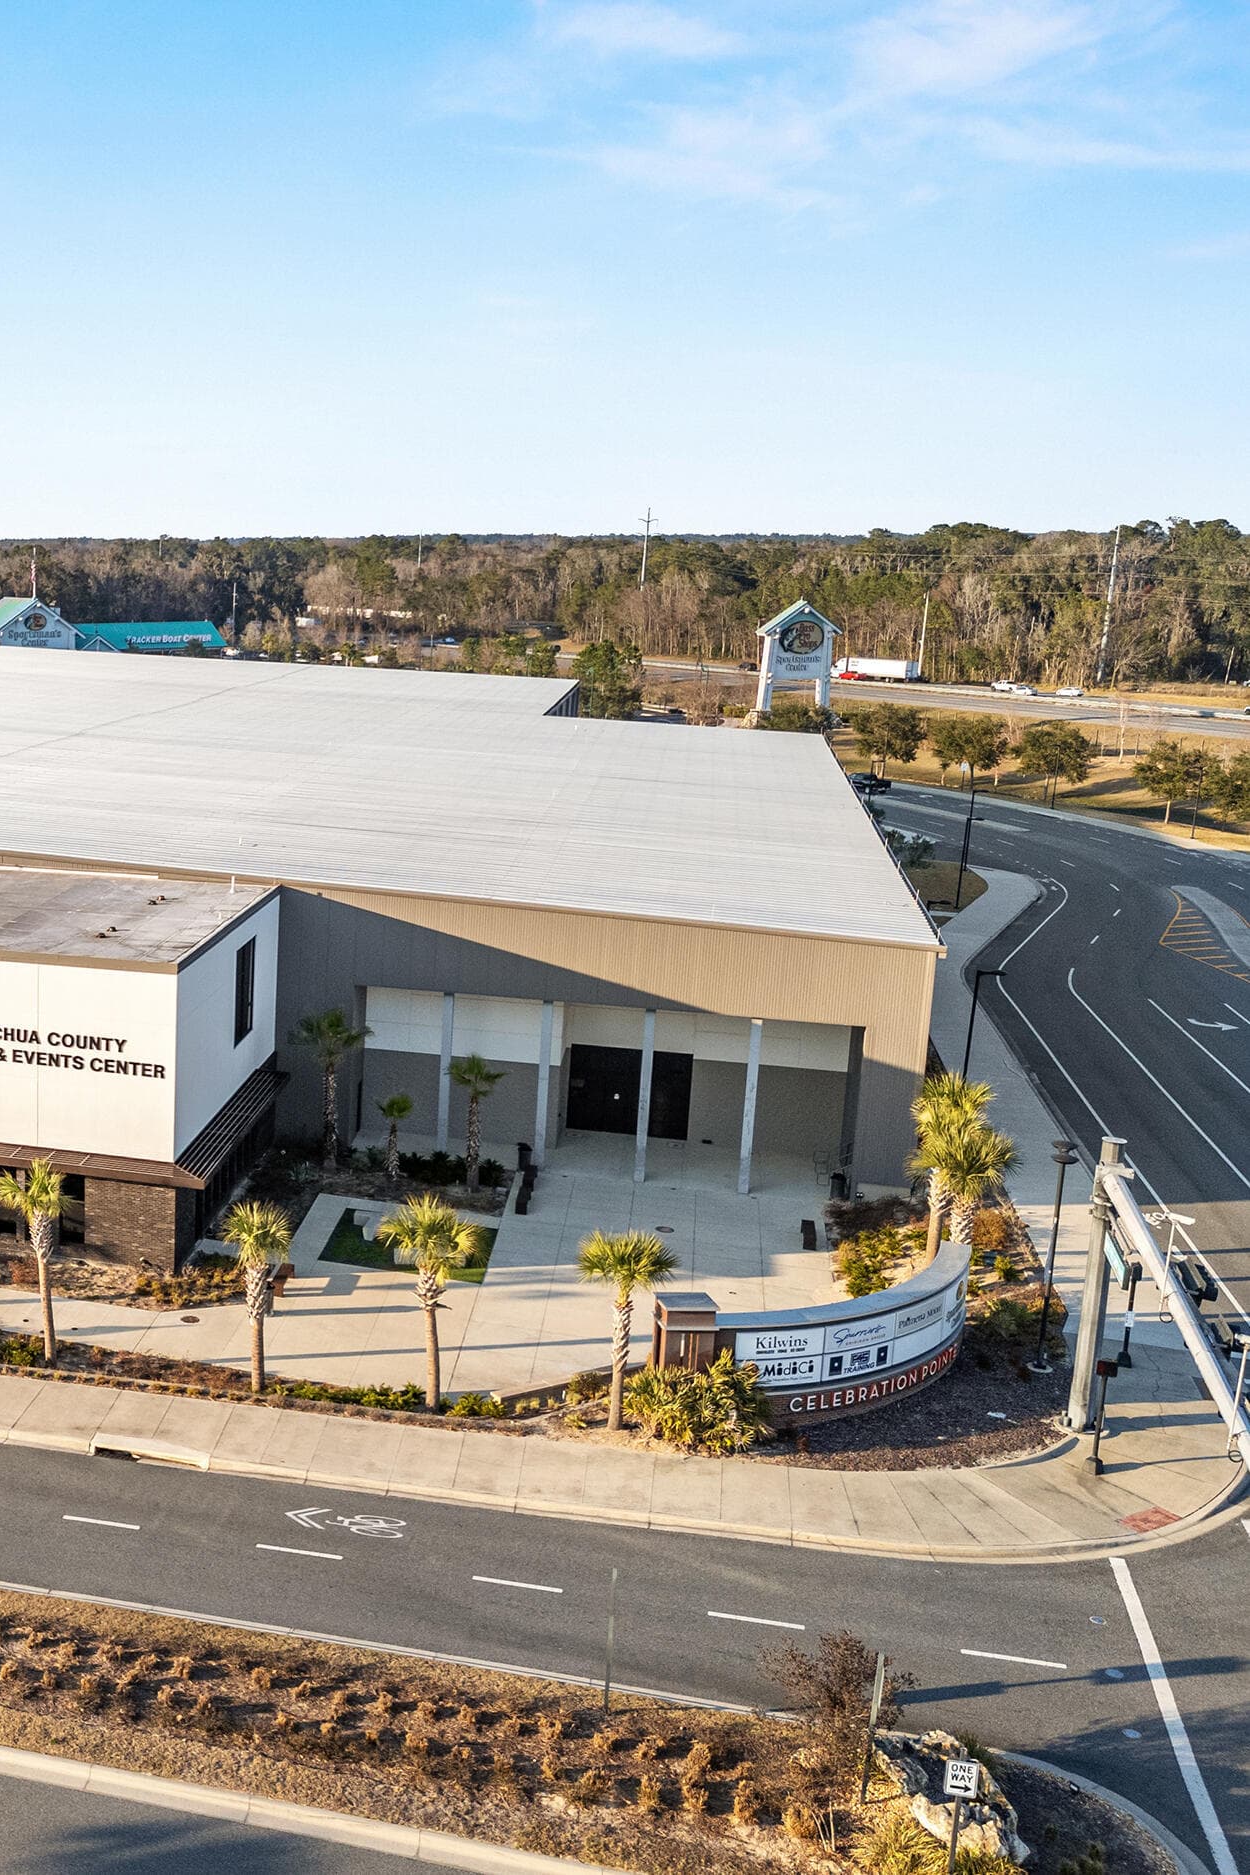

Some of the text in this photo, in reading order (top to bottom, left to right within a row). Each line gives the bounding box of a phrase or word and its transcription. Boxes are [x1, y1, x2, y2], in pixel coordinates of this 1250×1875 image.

[162, 634, 182, 643] BOAT
[47, 1032, 127, 1053] COUNTY
[12, 1049, 85, 1071] EVENTS
[90, 1057, 166, 1079] CENTER
[756, 1335, 808, 1349] Kilwins
[763, 1359, 814, 1377] MidiCi
[844, 1361, 876, 1374] TRAINING
[789, 1343, 958, 1412] CELEBRATION POINTE
[951, 1763, 973, 1775] ONE
[951, 1773, 973, 1783] WAY
